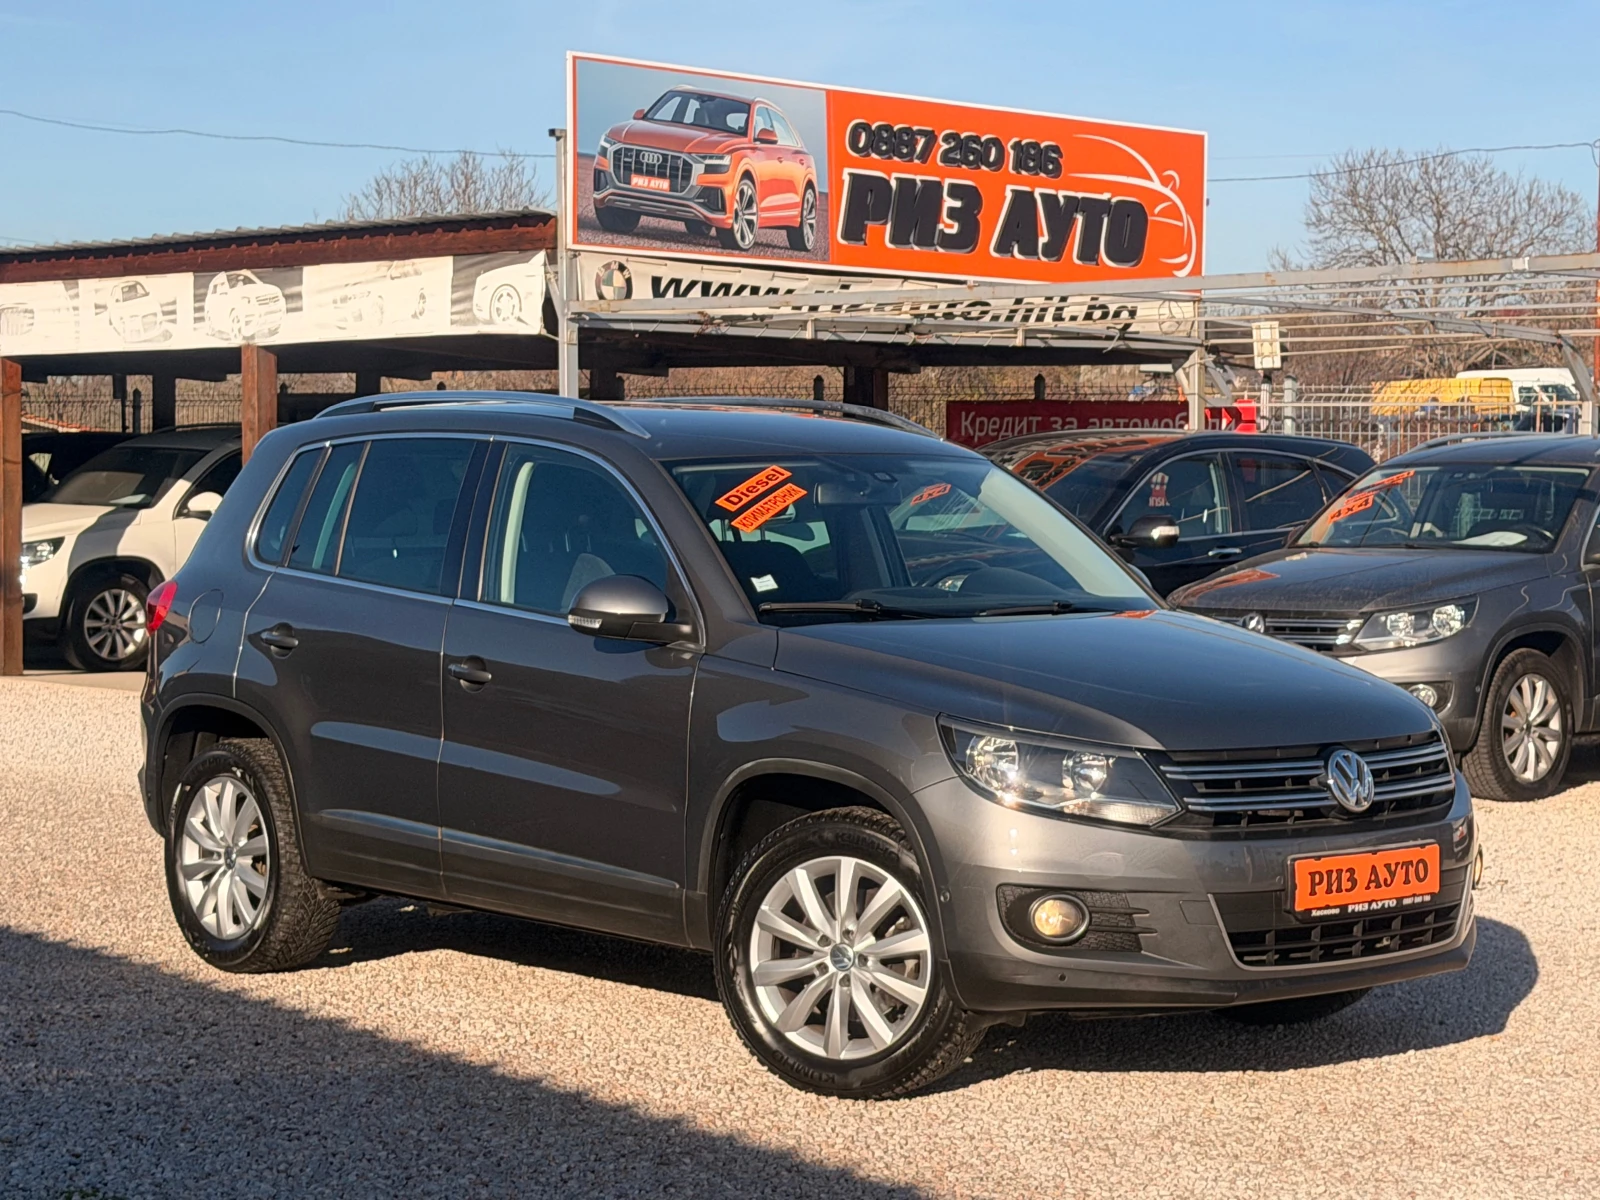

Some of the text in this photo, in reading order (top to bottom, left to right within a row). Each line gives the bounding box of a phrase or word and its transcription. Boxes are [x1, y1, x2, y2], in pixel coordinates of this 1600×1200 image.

[846, 119, 1063, 179] 0887 260 186
[837, 168, 1149, 267] РИЗ АУТО
[960, 411, 1236, 441] Кредит за автомобли
[723, 468, 786, 506] Diesel
[737, 485, 803, 529] КЛИМАТРОНИК
[1309, 858, 1429, 897] РИЗ АУТО
[1347, 902, 1369, 914] РИЗ
[1370, 899, 1397, 911] АУТО
